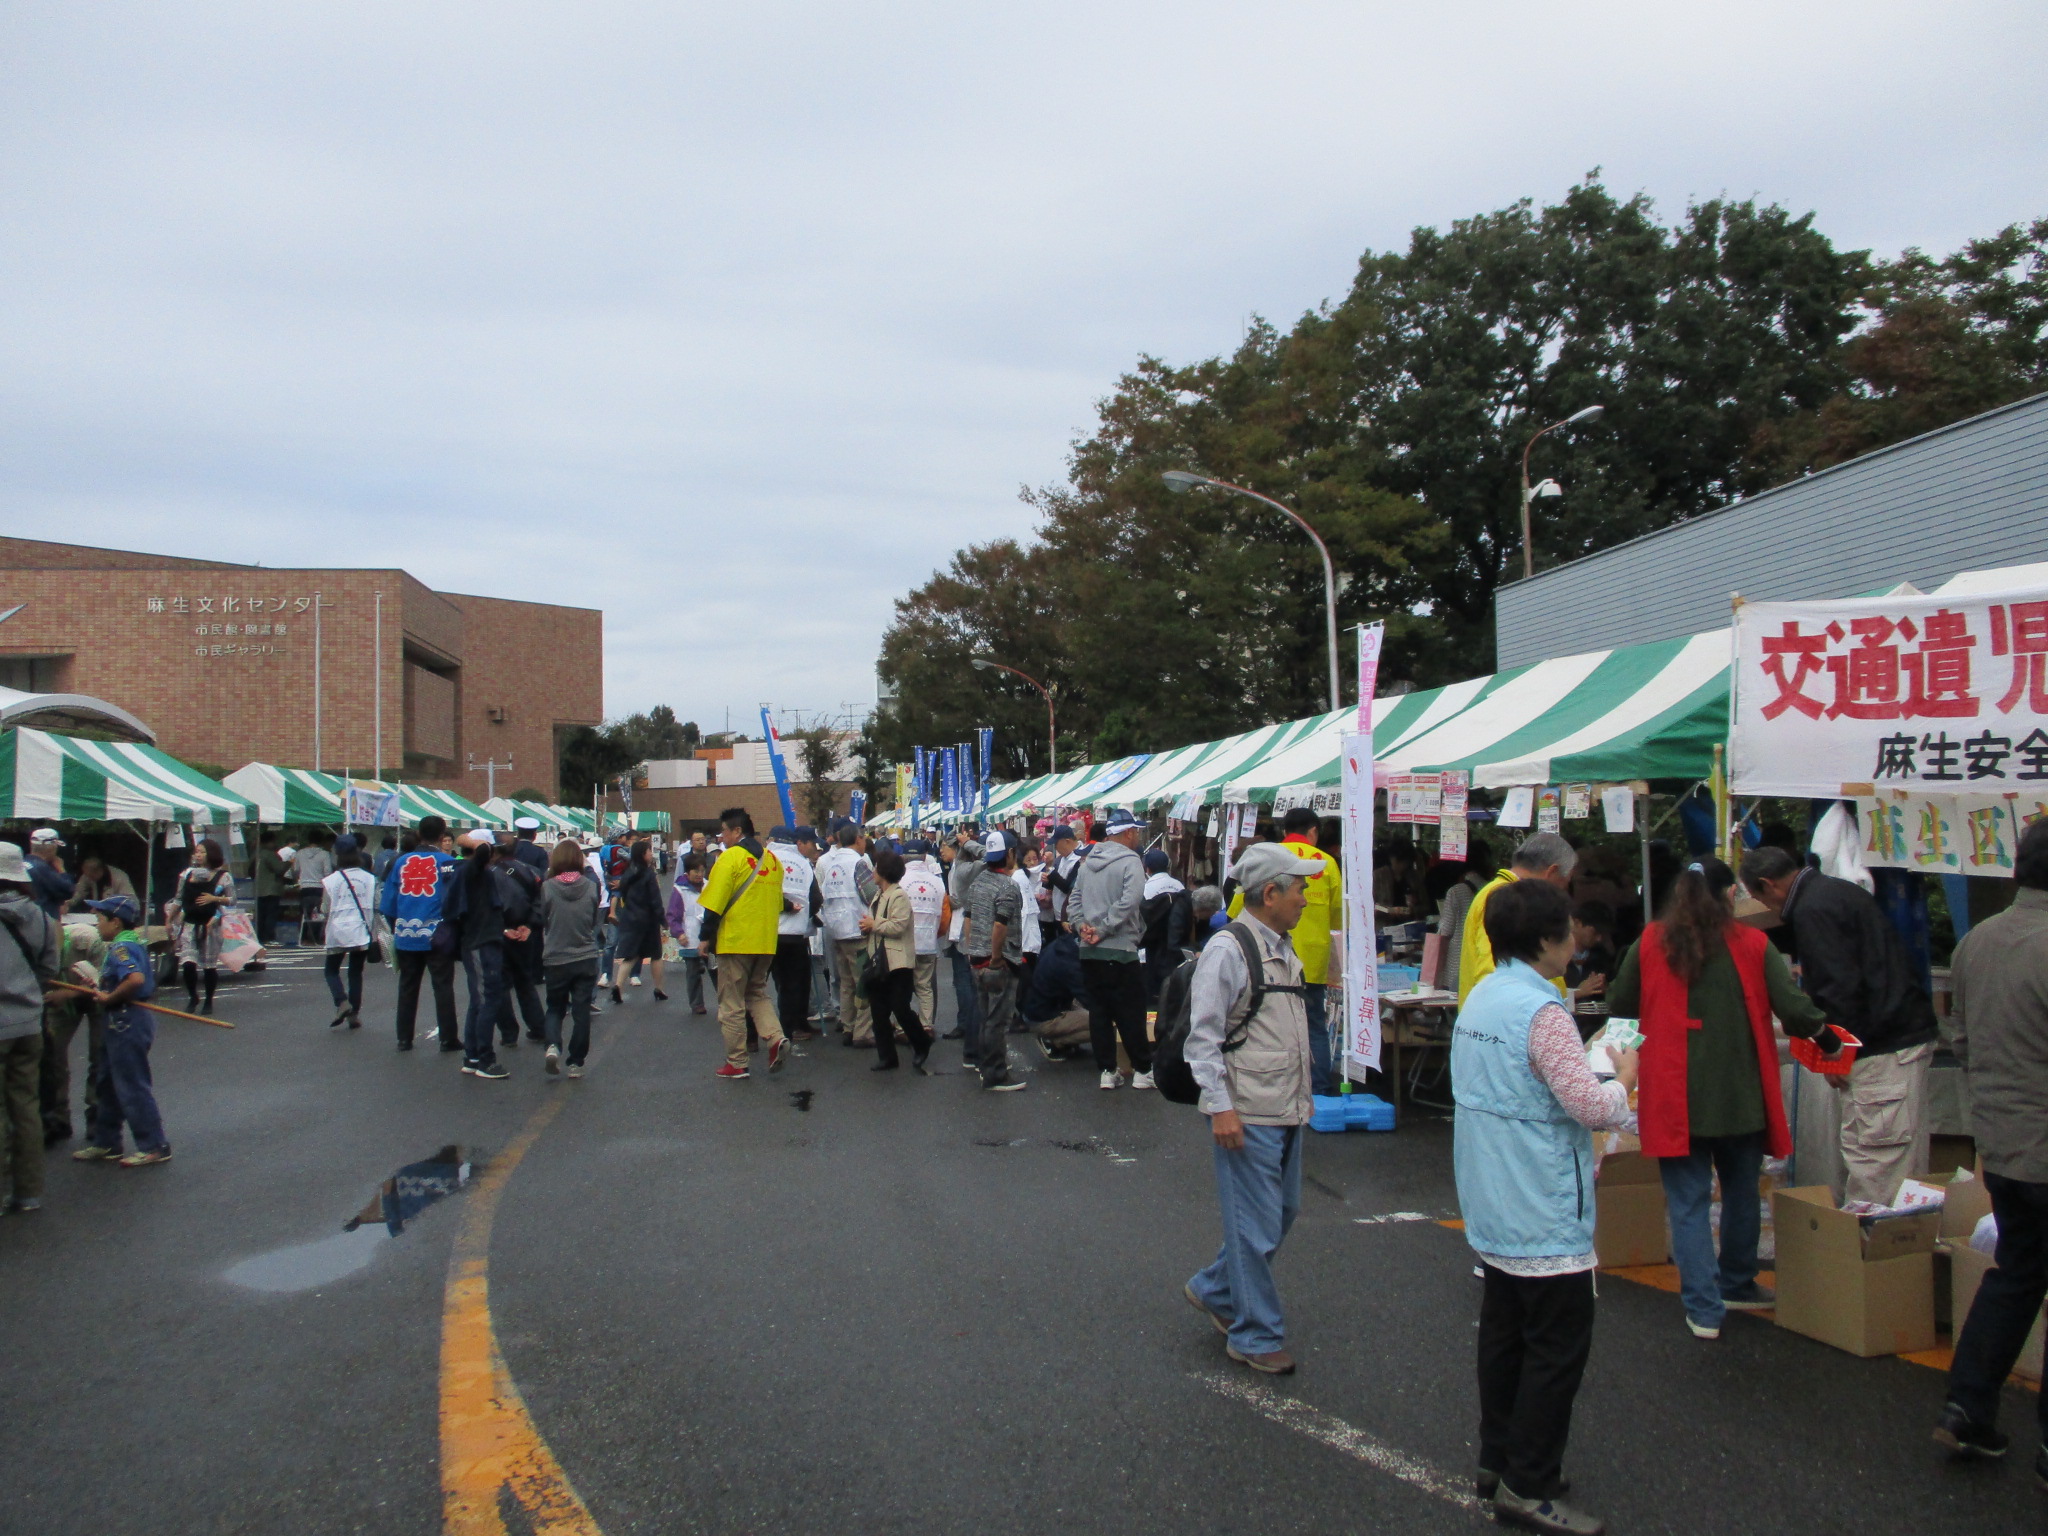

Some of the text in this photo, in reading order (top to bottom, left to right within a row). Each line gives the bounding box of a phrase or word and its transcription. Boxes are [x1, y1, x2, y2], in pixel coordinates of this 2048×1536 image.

[147, 597, 334, 613] 麻生文化センター
[195, 644, 286, 657] 市民ギャラリー
[1760, 601, 2048, 721] 交通遺児
[1873, 728, 2048, 780] 麻生安全
[1867, 797, 2048, 868] 麻生区
[401, 855, 438, 896] 祭
